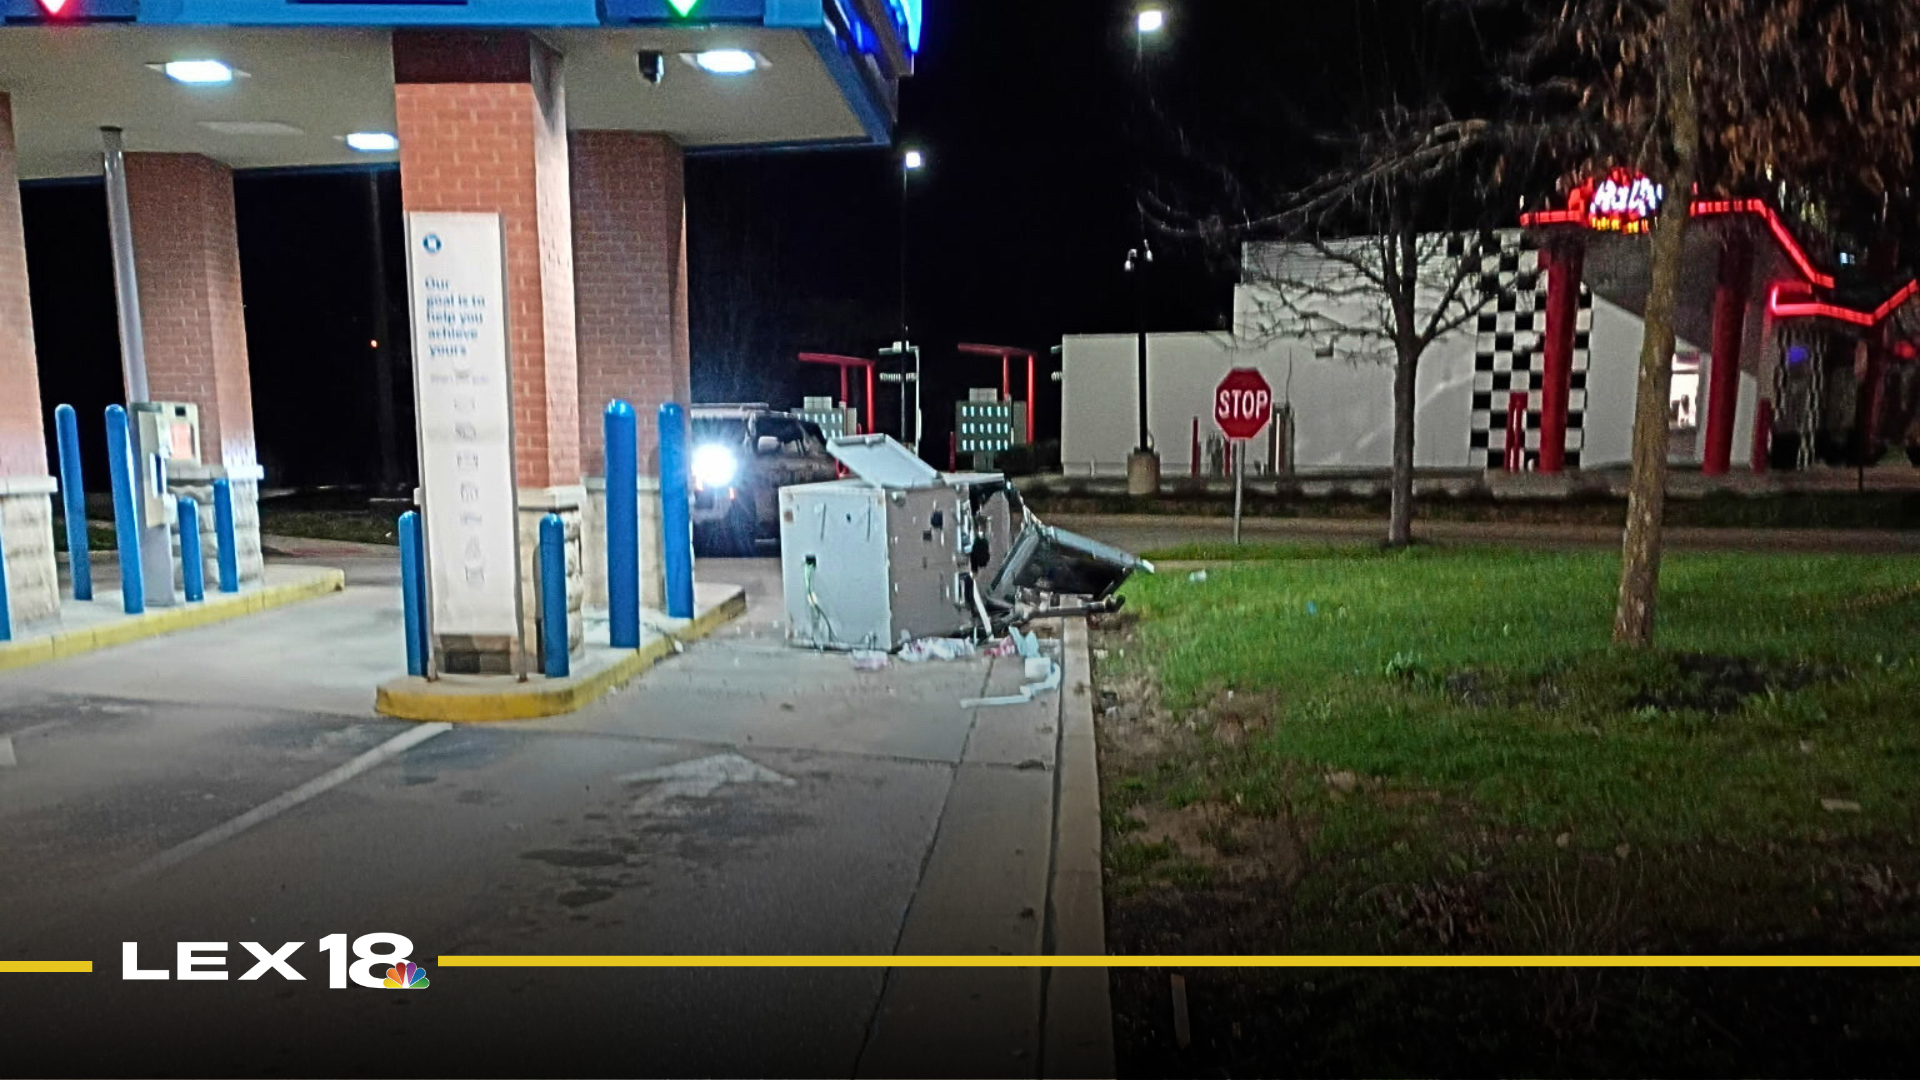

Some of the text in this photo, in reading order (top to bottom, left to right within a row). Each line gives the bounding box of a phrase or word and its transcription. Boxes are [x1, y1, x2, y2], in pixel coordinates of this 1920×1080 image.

[424, 276, 450, 290] Our
[426, 294, 486, 309] goal is to
[426, 308, 483, 326] help you
[428, 327, 478, 341] achieve
[1218, 389, 1269, 420] STOP
